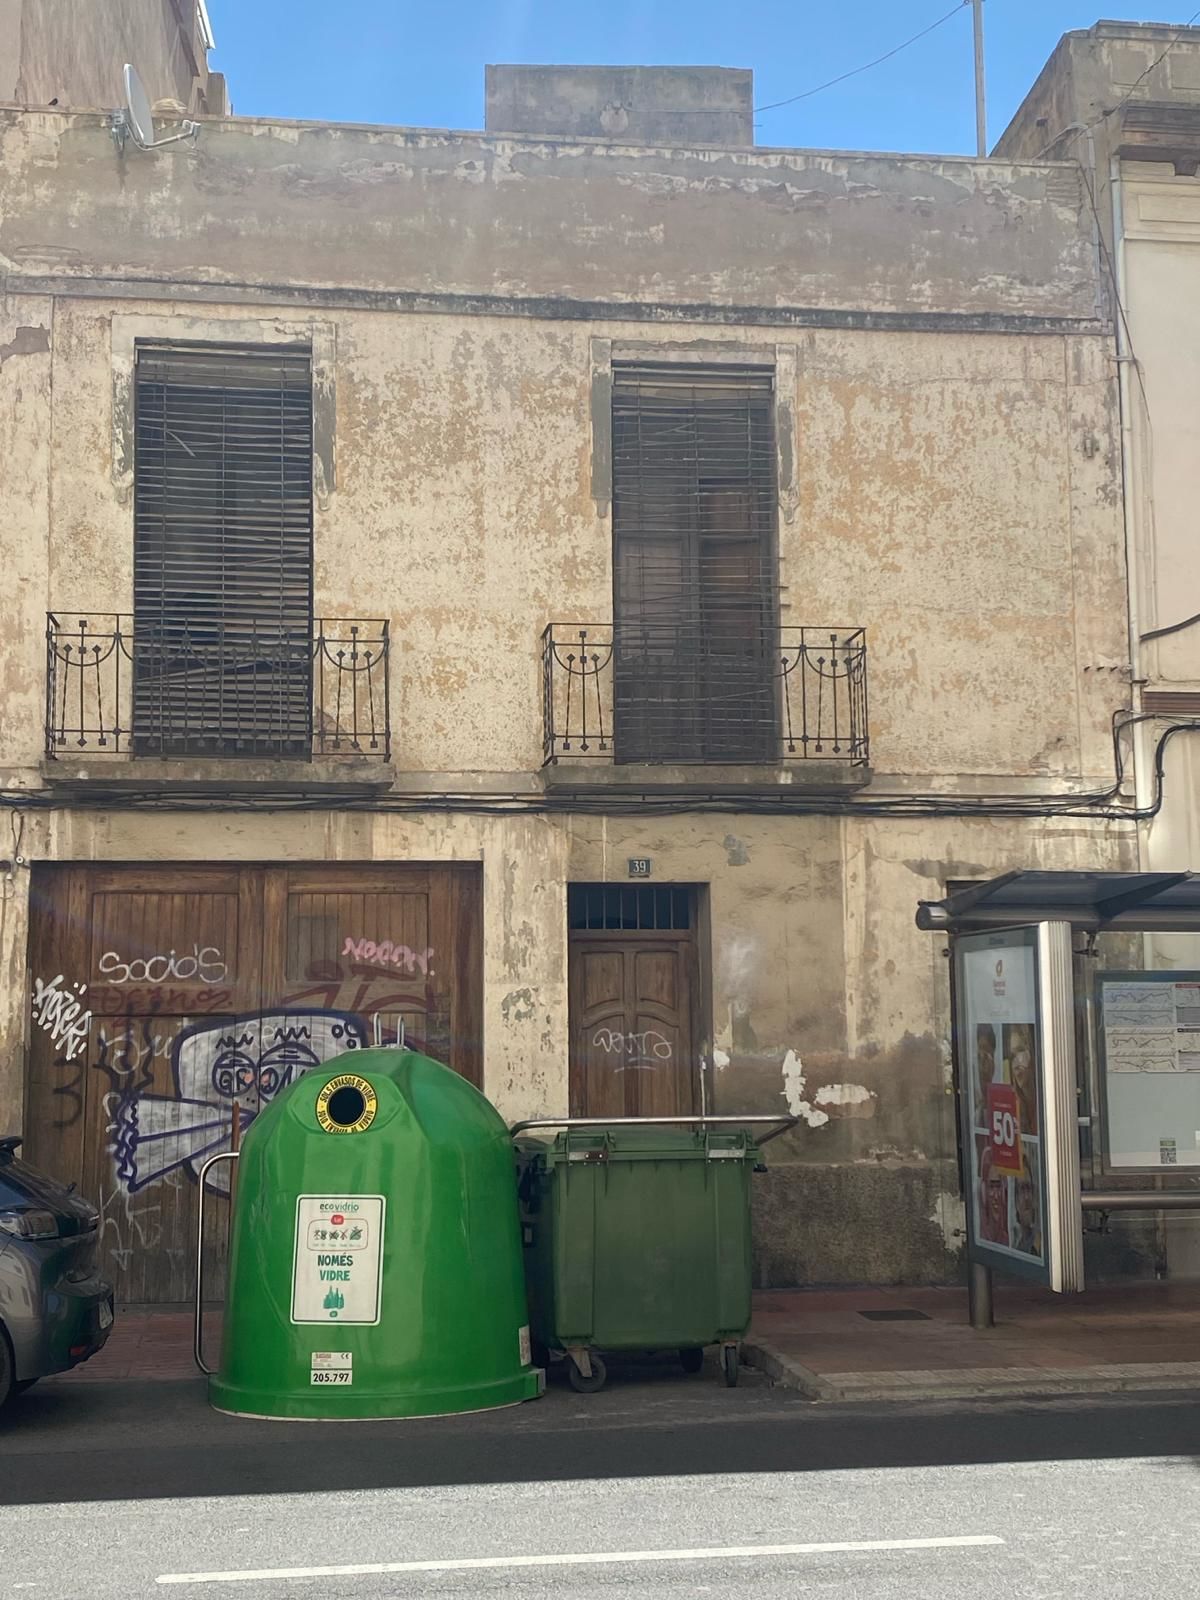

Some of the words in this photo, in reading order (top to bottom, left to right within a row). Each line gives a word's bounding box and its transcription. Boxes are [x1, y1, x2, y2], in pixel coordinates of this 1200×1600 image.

[633, 860, 646, 873] 39
[320, 1086, 332, 1103] SOLS
[330, 1076, 356, 1090] ENVASOS
[355, 1079, 364, 1089] DE
[361, 1083, 376, 1103] VIDRE
[358, 1110, 375, 1130] VIDRIO
[319, 1202, 359, 1212] ecovidrio
[317, 1251, 353, 1267] NOMÉS
[319, 1269, 350, 1281] VIDRE
[312, 1373, 350, 1383] 205.797
